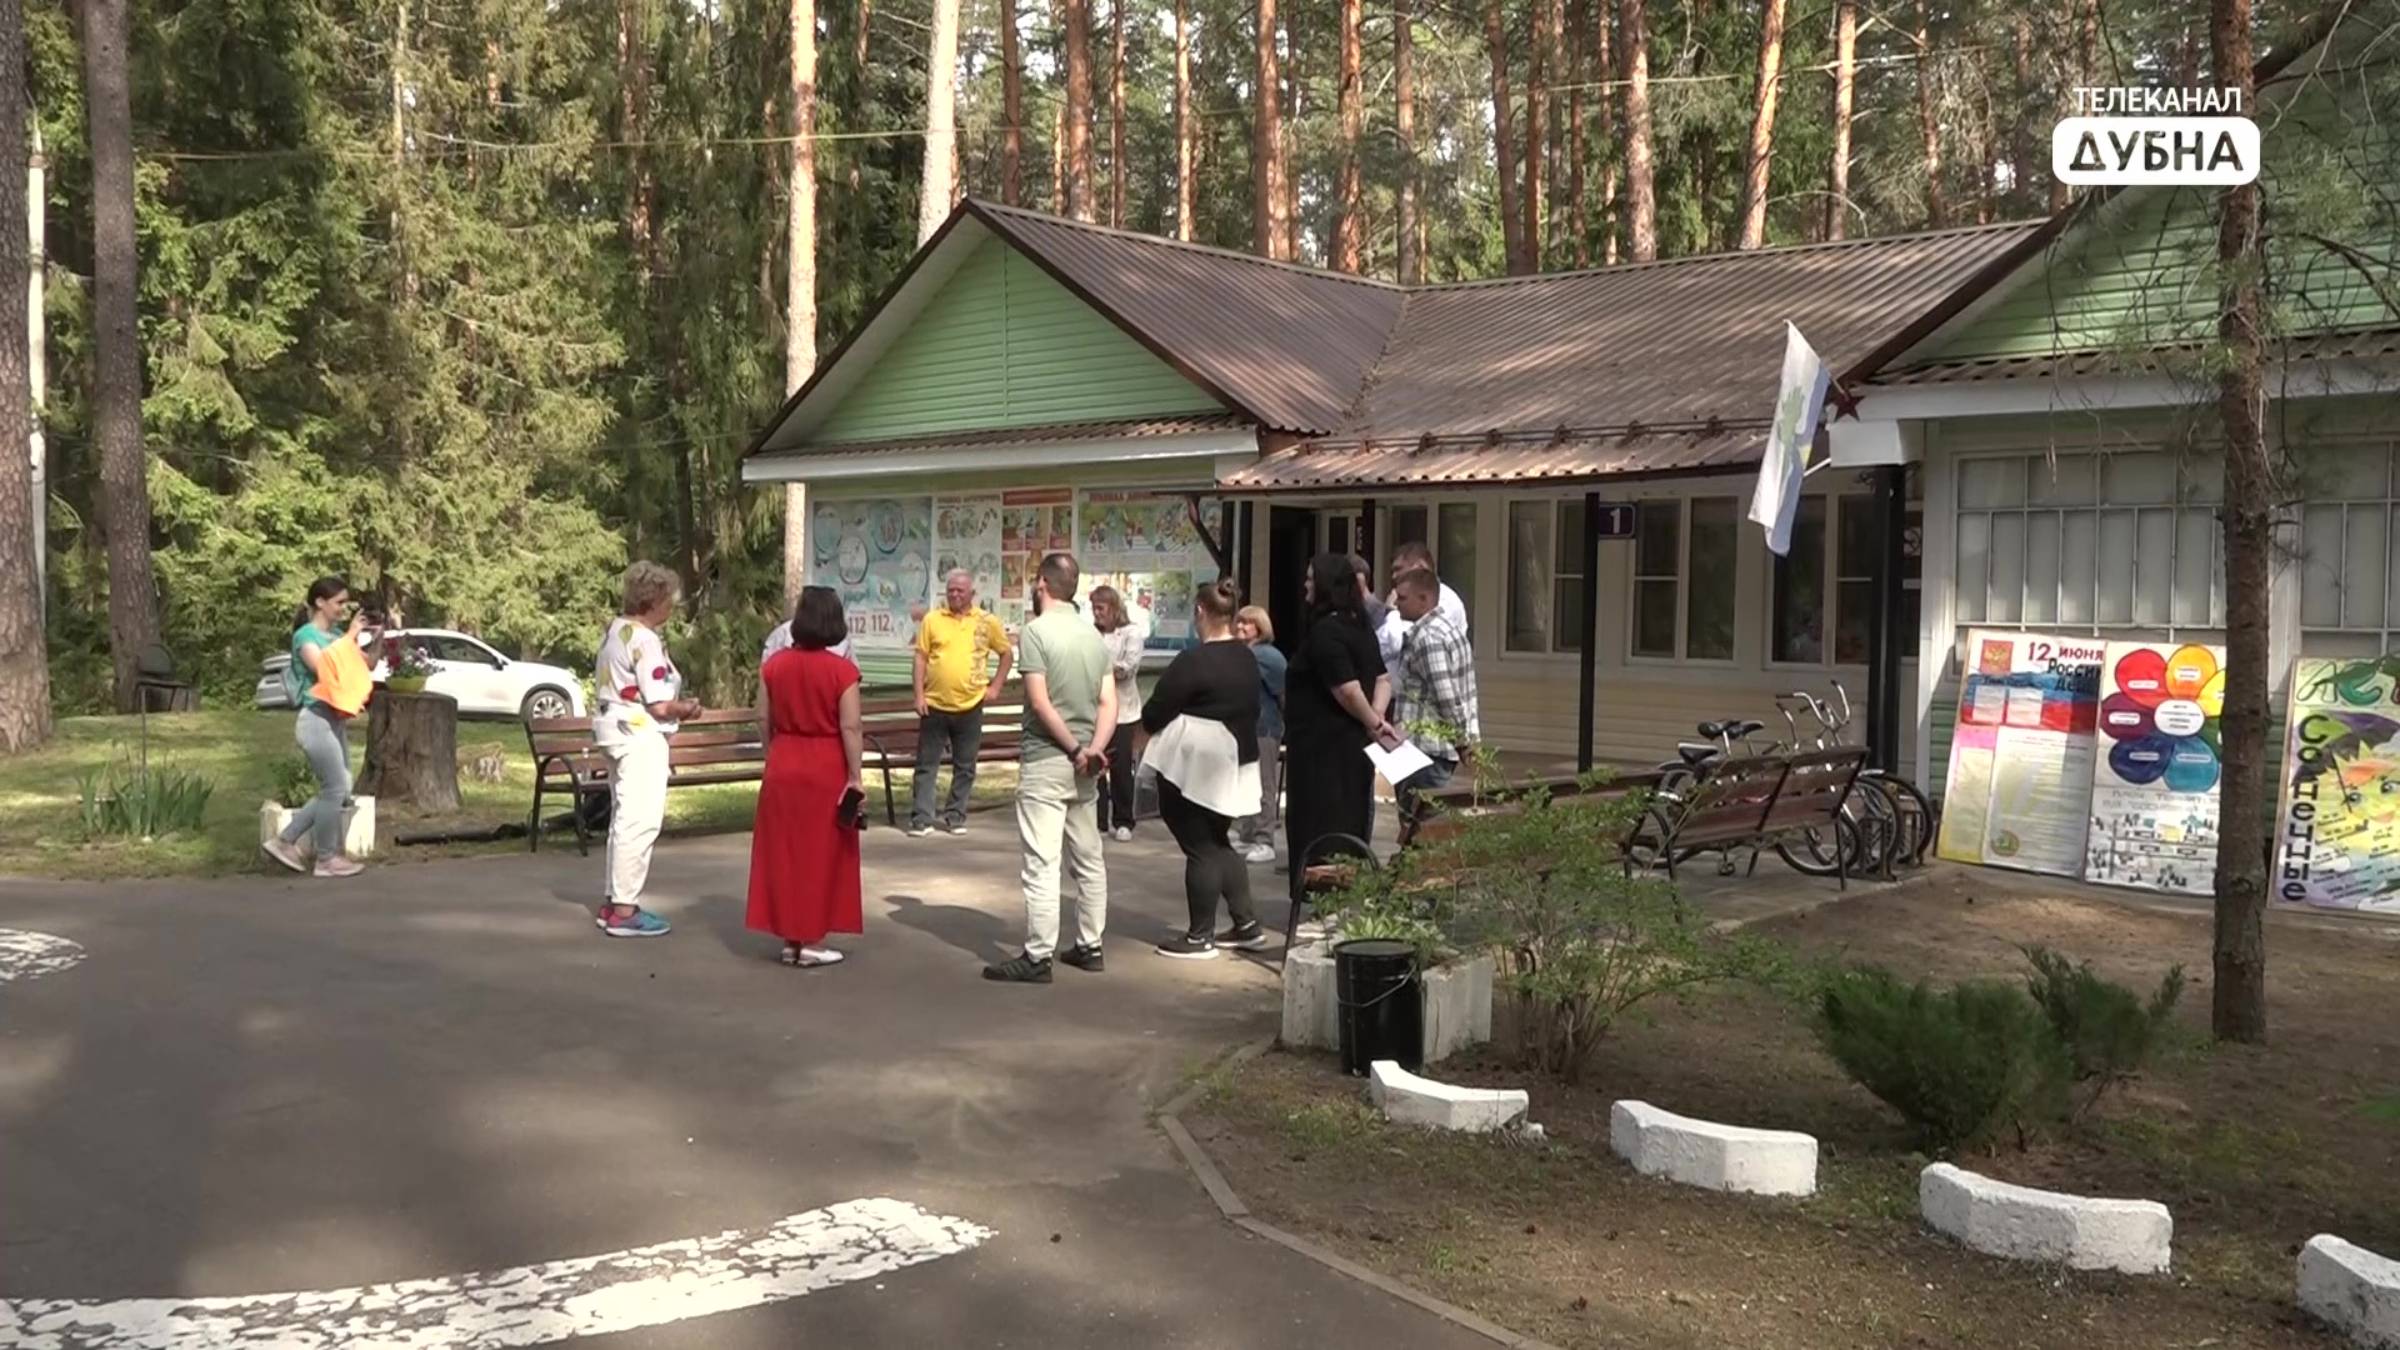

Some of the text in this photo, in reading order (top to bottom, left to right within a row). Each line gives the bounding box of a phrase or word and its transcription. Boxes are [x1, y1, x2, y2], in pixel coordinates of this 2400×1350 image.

[1610, 508, 1620, 534] 1
[849, 616, 866, 634] 112
[2028, 642, 2052, 661] 12
[2282, 714, 2331, 901] Сонечные
